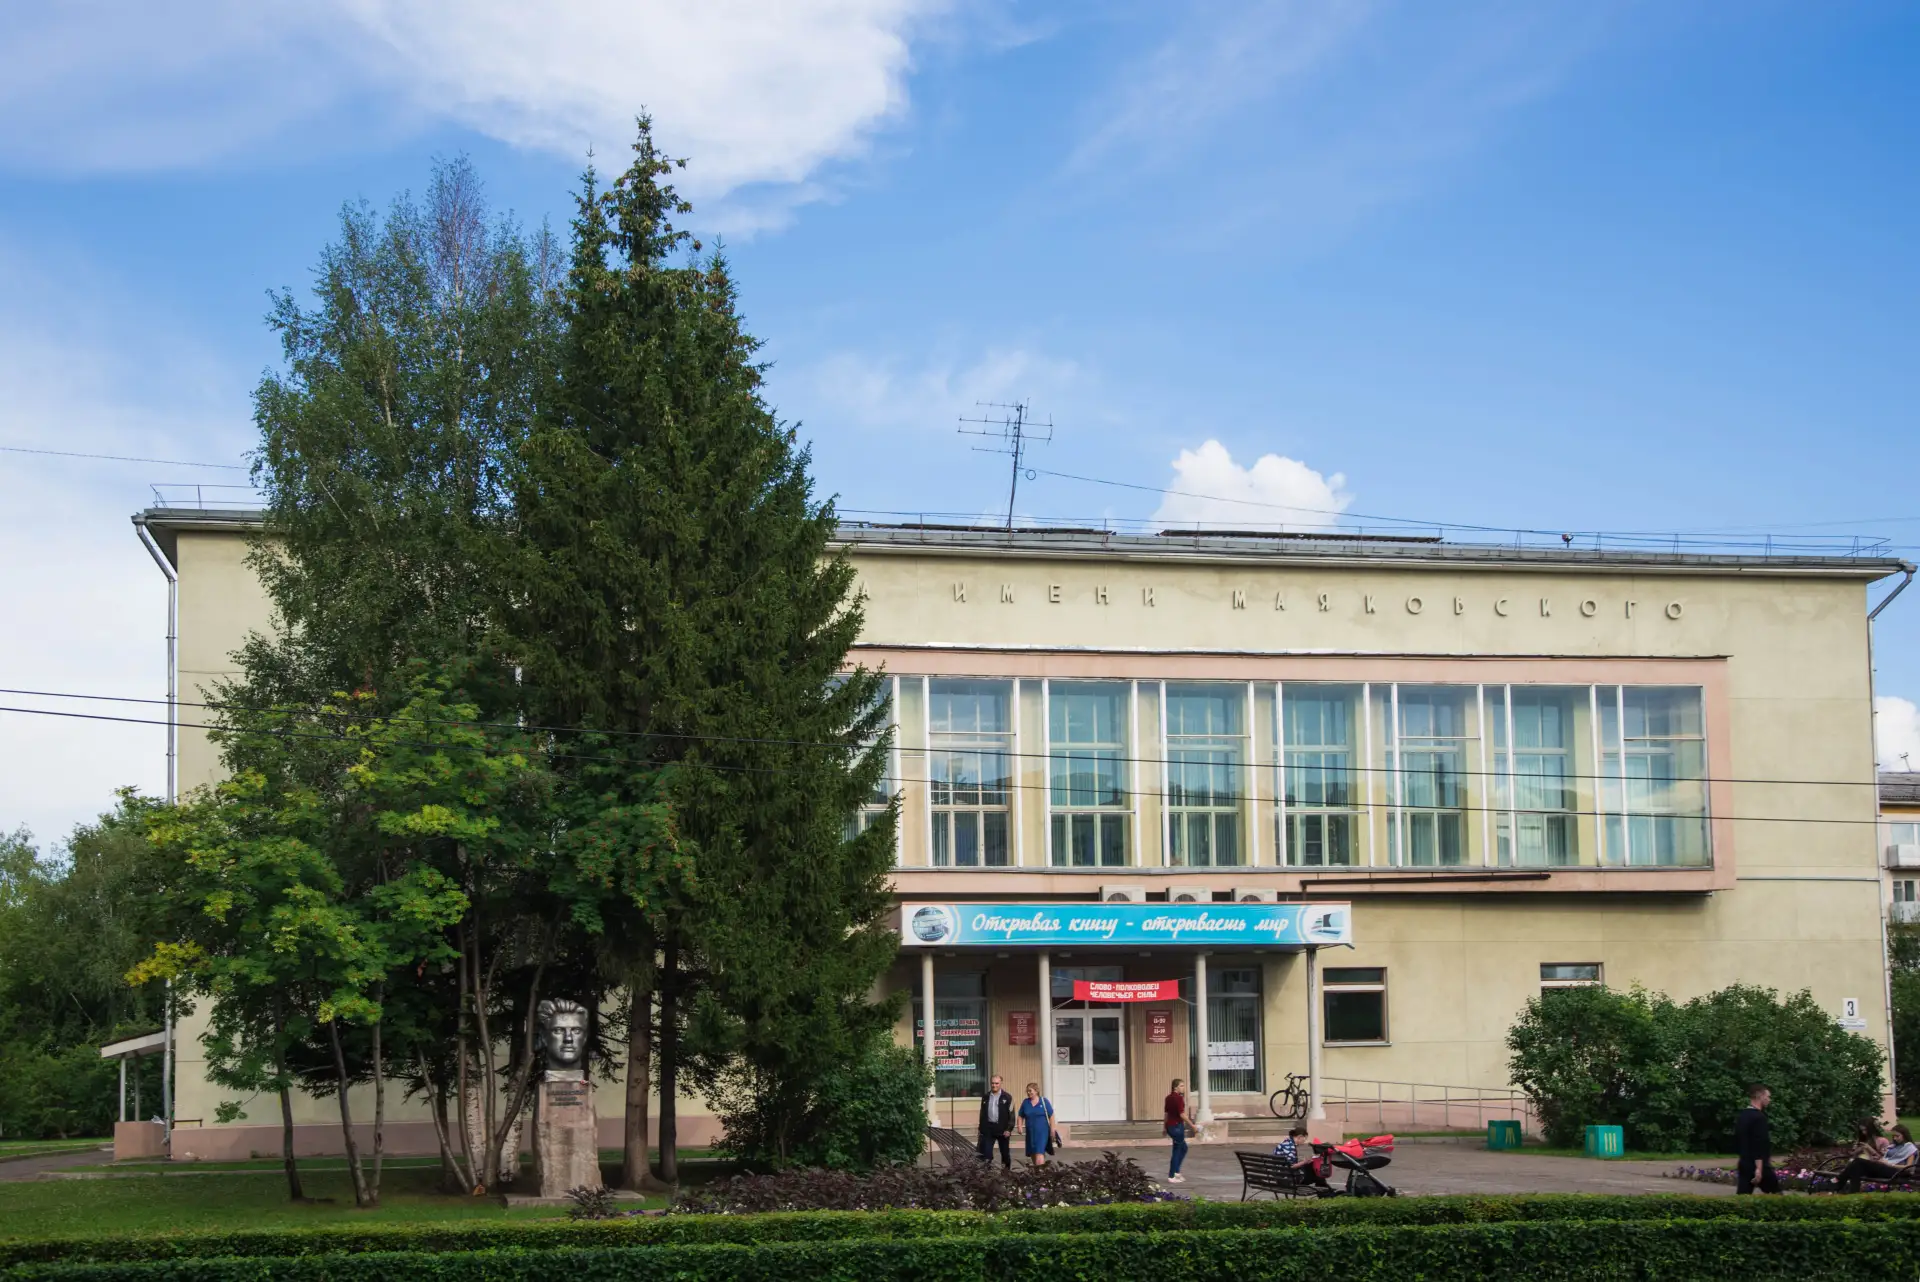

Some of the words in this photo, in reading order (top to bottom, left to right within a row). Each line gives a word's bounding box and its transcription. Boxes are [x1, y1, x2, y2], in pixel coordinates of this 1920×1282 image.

[953, 583, 1156, 606] ИМЕНИ
[1233, 589, 1684, 620] МАЯКОВСКОГО
[972, 911, 1061, 939] Открывая
[1068, 917, 1119, 939] книгу
[1142, 911, 1246, 939] открываешь
[1253, 917, 1289, 938] мир
[1847, 1001, 1855, 1016] 3
